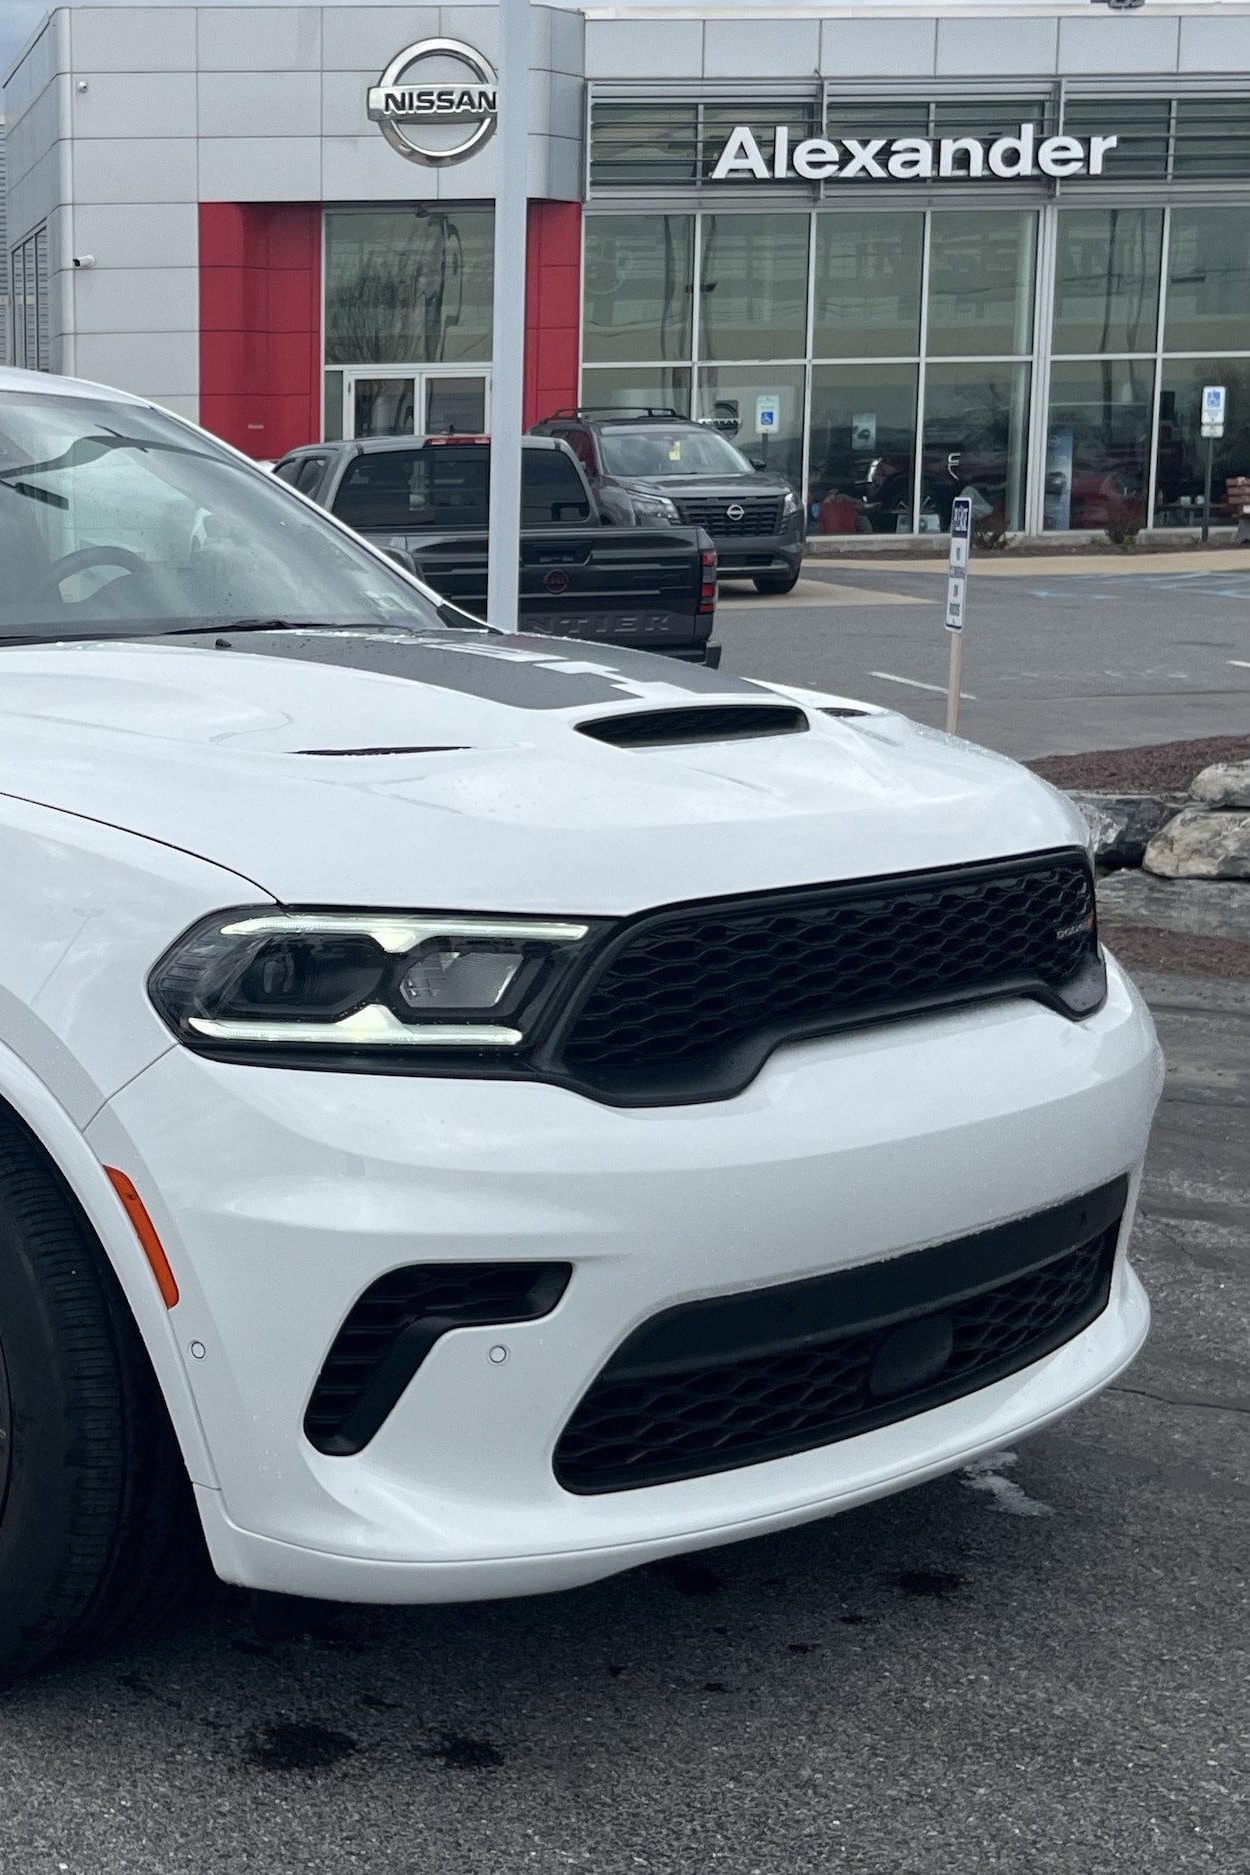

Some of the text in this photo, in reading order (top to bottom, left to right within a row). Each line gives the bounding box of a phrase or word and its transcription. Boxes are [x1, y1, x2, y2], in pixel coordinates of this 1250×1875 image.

[383, 90, 498, 114] NISSAN
[710, 122, 1120, 180] Alexander
[526, 614, 670, 634] NTIER
